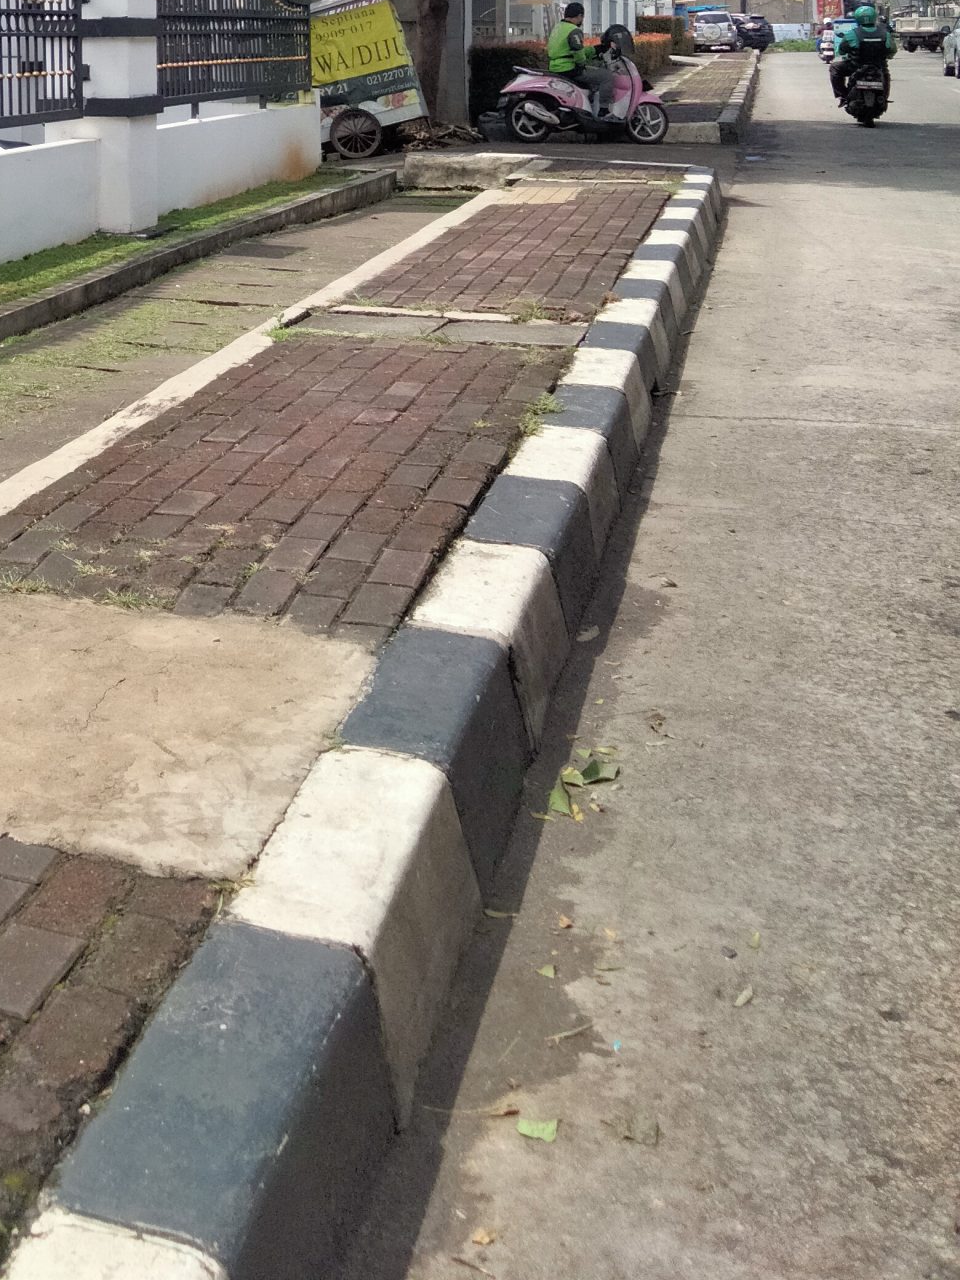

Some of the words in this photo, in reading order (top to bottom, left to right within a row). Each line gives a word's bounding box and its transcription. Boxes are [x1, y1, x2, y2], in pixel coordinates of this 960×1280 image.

[321, 8, 375, 27] Septiana
[311, 36, 405, 76] WA/DIJU
[382, 68, 404, 81] 2270
[336, 82, 348, 95] 21
